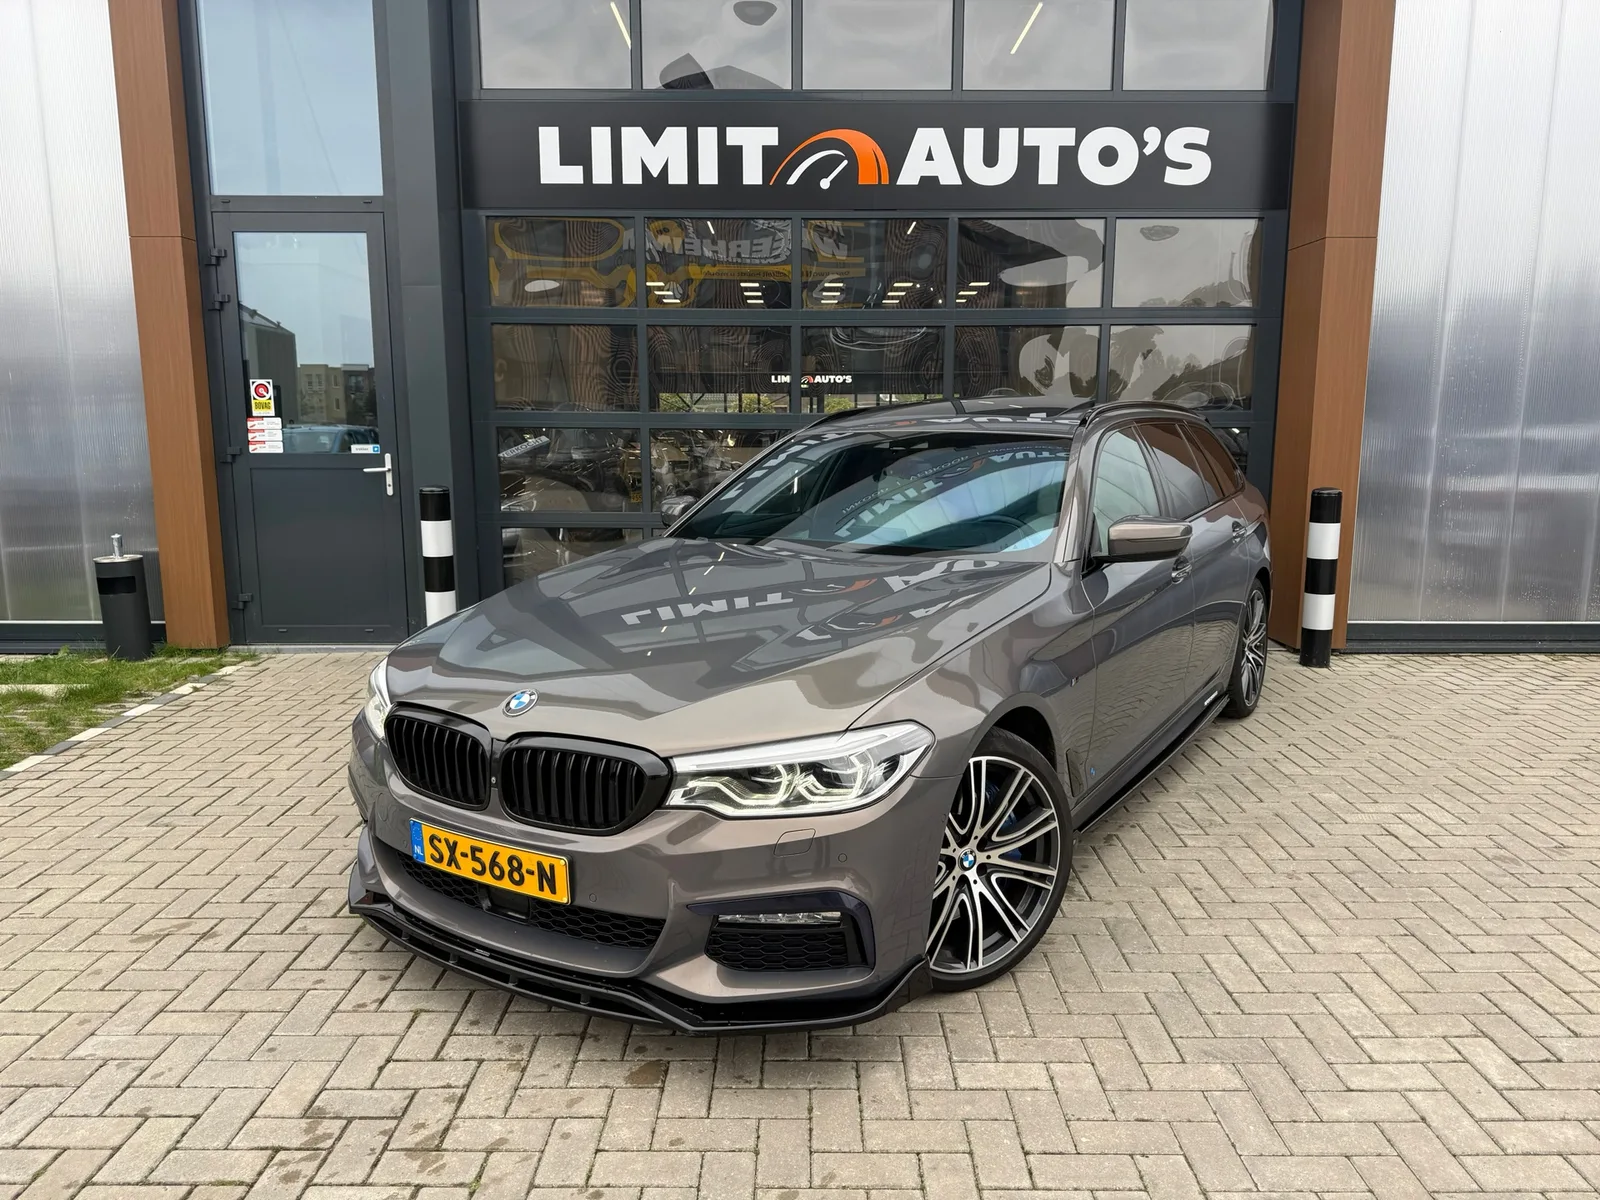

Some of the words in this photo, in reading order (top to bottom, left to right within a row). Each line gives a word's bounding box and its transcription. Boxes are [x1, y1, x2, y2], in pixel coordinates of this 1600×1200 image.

[538, 126, 779, 185] LIMIT
[896, 126, 1212, 186] AUTO'S
[771, 375, 791, 384] LIM
[813, 375, 853, 384] AUTO'S
[254, 401, 272, 410] BOVAG
[414, 844, 424, 856] NL
[428, 833, 558, 895] SX-568-N
